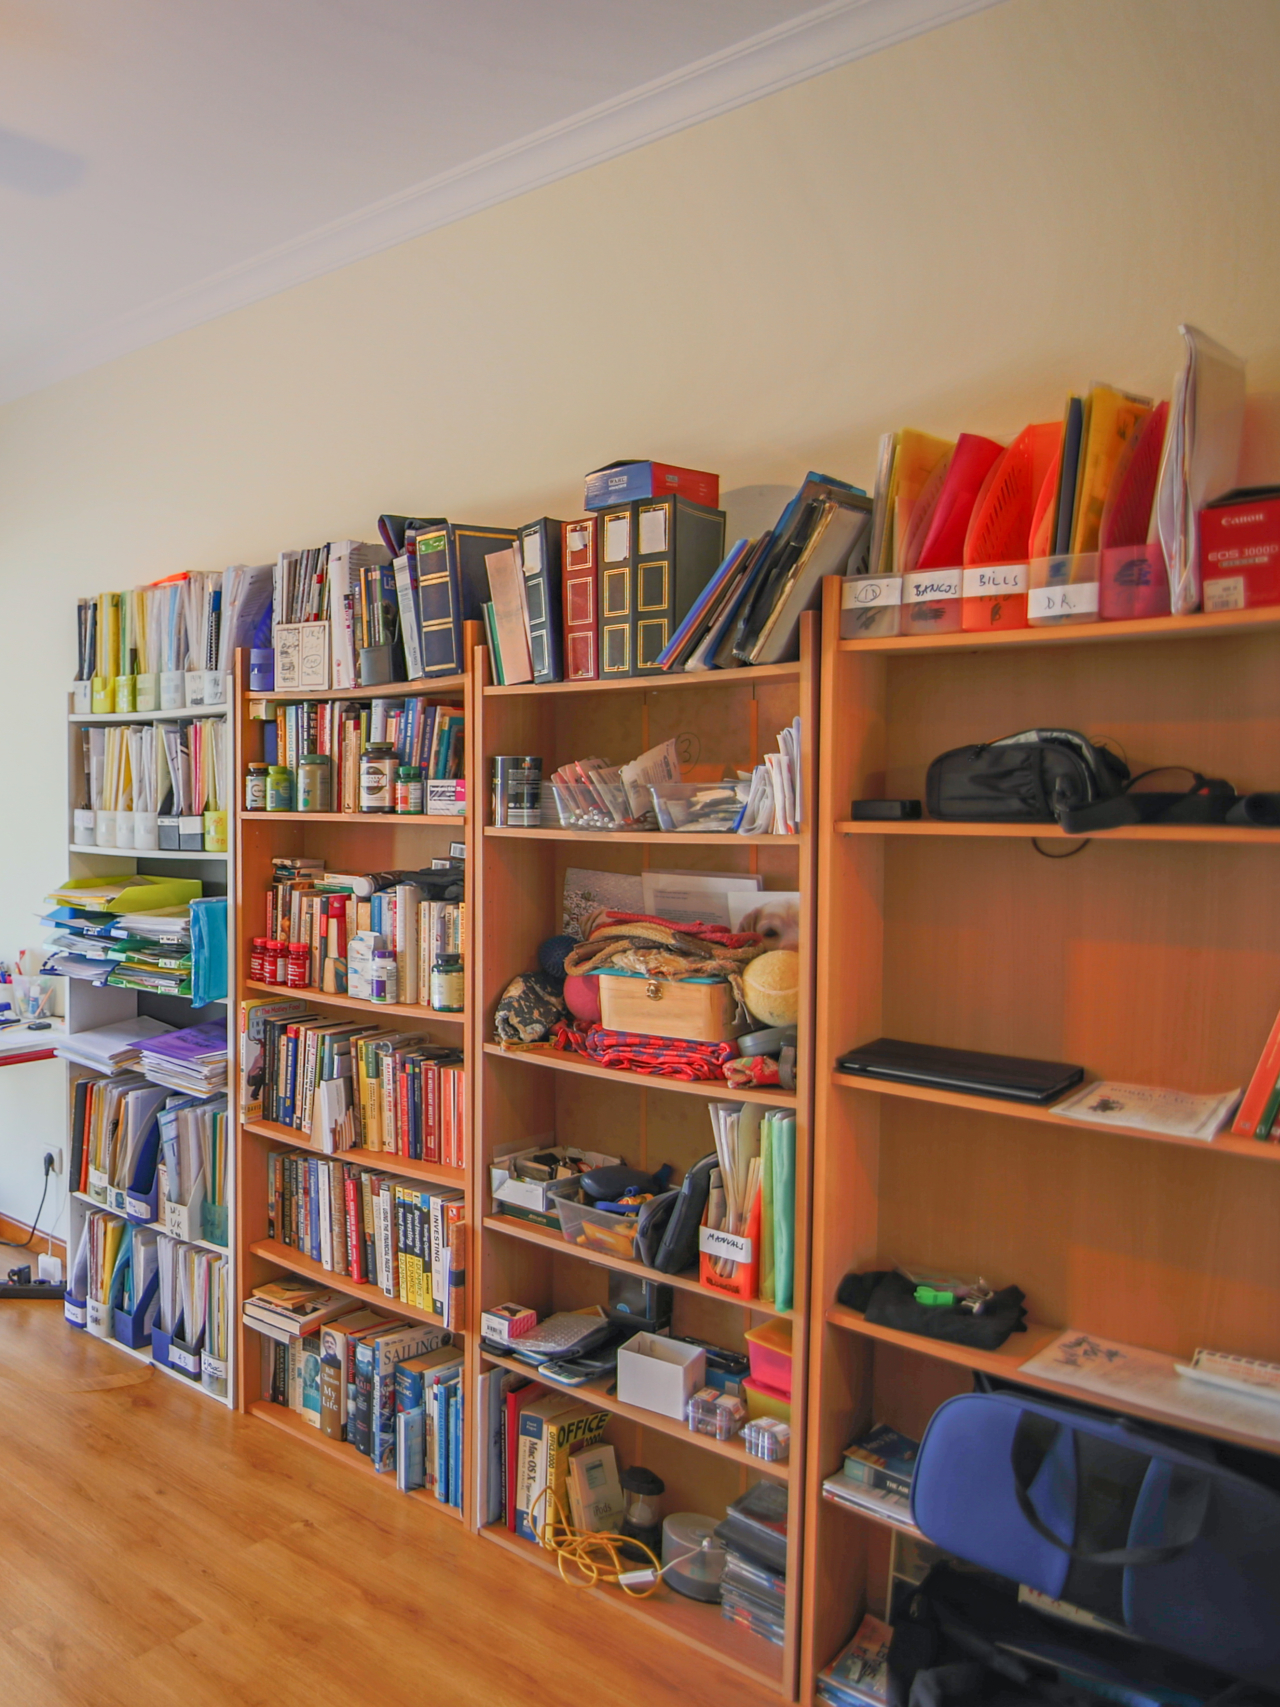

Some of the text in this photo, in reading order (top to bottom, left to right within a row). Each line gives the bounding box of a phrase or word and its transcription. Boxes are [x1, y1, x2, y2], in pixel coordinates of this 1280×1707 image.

[1222, 514, 1264, 526] Canon
[1208, 550, 1239, 561] EOS
[979, 571, 1019, 586] BILLS
[914, 585, 958, 596] BANCOS
[271, 1005, 288, 1013] Motley
[247, 1104, 261, 1113] DAVID
[170, 1219, 182, 1230] UK
[707, 1233, 744, 1250] MANUALS
[384, 1336, 439, 1365] SAILING
[322, 1373, 340, 1385] Clinton
[323, 1385, 337, 1399] My
[322, 1396, 339, 1411] Life
[558, 1413, 609, 1448] OFFICE
[528, 1440, 538, 1459] Mac
[528, 1460, 537, 1473] OS
[527, 1474, 536, 1482] X
[886, 1480, 897, 1488] THE
[593, 1503, 612, 1515] iPods
